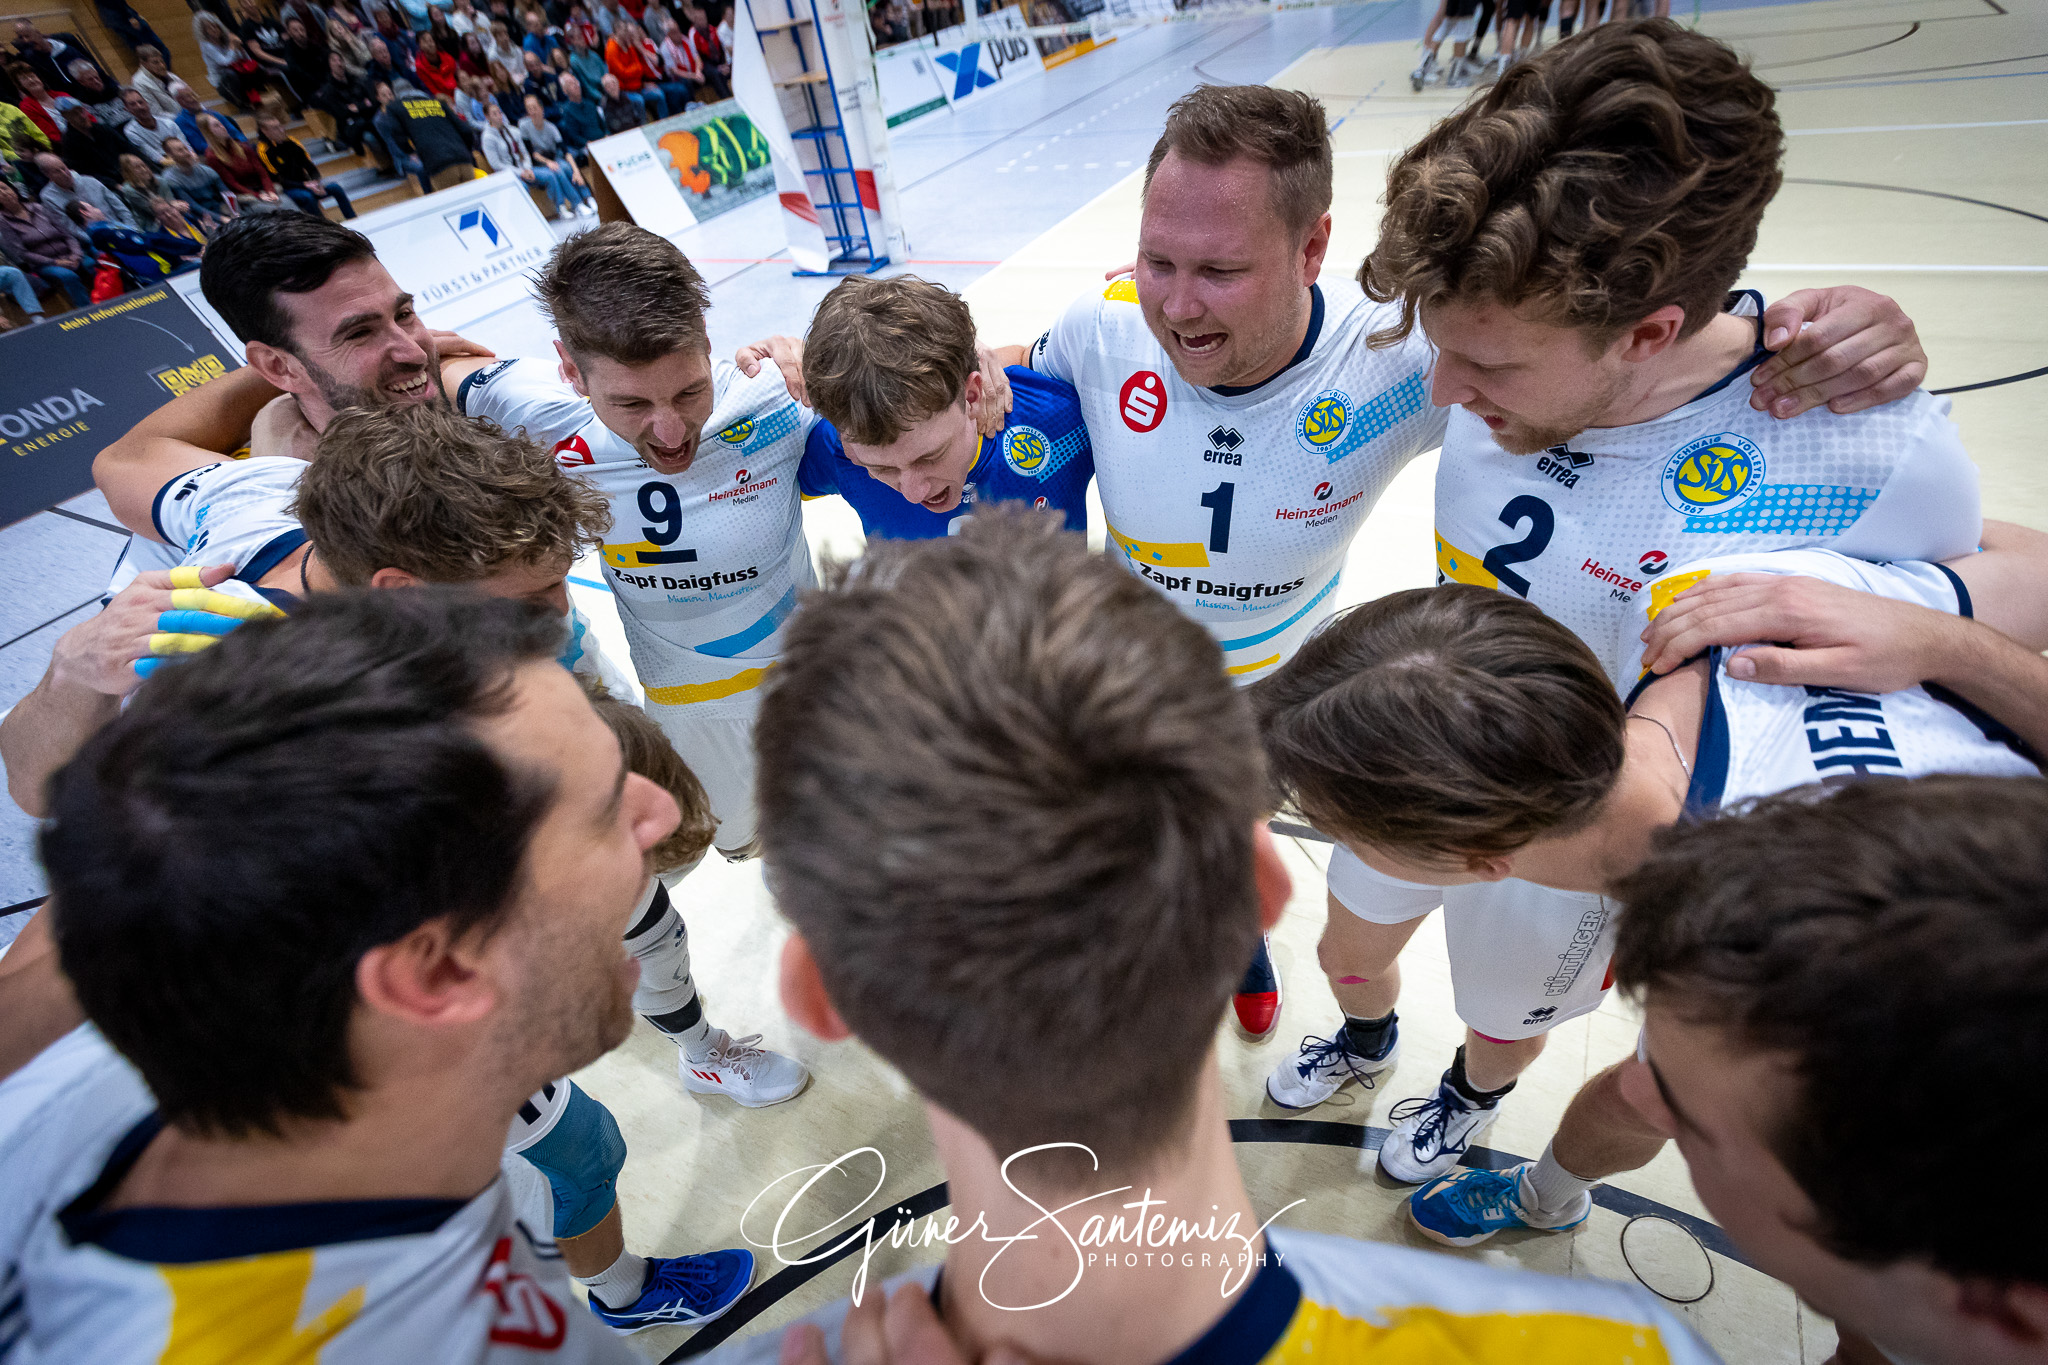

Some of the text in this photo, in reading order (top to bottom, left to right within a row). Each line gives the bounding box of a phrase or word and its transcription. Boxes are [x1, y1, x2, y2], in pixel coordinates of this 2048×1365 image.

[58, 289, 168, 332] Mehr Informationen!
[12, 420, 90, 457] ENERGIE
[1316, 443, 1333, 452] 1967
[1203, 450, 1243, 467] errea
[1536, 456, 1582, 489] errea
[1672, 436, 1722, 466] SCHWAIG
[1737, 439, 1763, 498] VOLLEYBALL
[708, 477, 778, 502] Heinzelmann
[732, 493, 759, 506] Medien
[637, 481, 682, 546] 9
[1200, 481, 1235, 554] 1
[1275, 491, 1364, 521] Heinzelmann
[1304, 514, 1339, 529] Medien
[1678, 502, 1705, 515] 1967
[1482, 494, 1555, 599] 2
[610, 565, 759, 591] Zapf Daigfuss
[1138, 563, 1305, 602] Zapf Daigfuss
